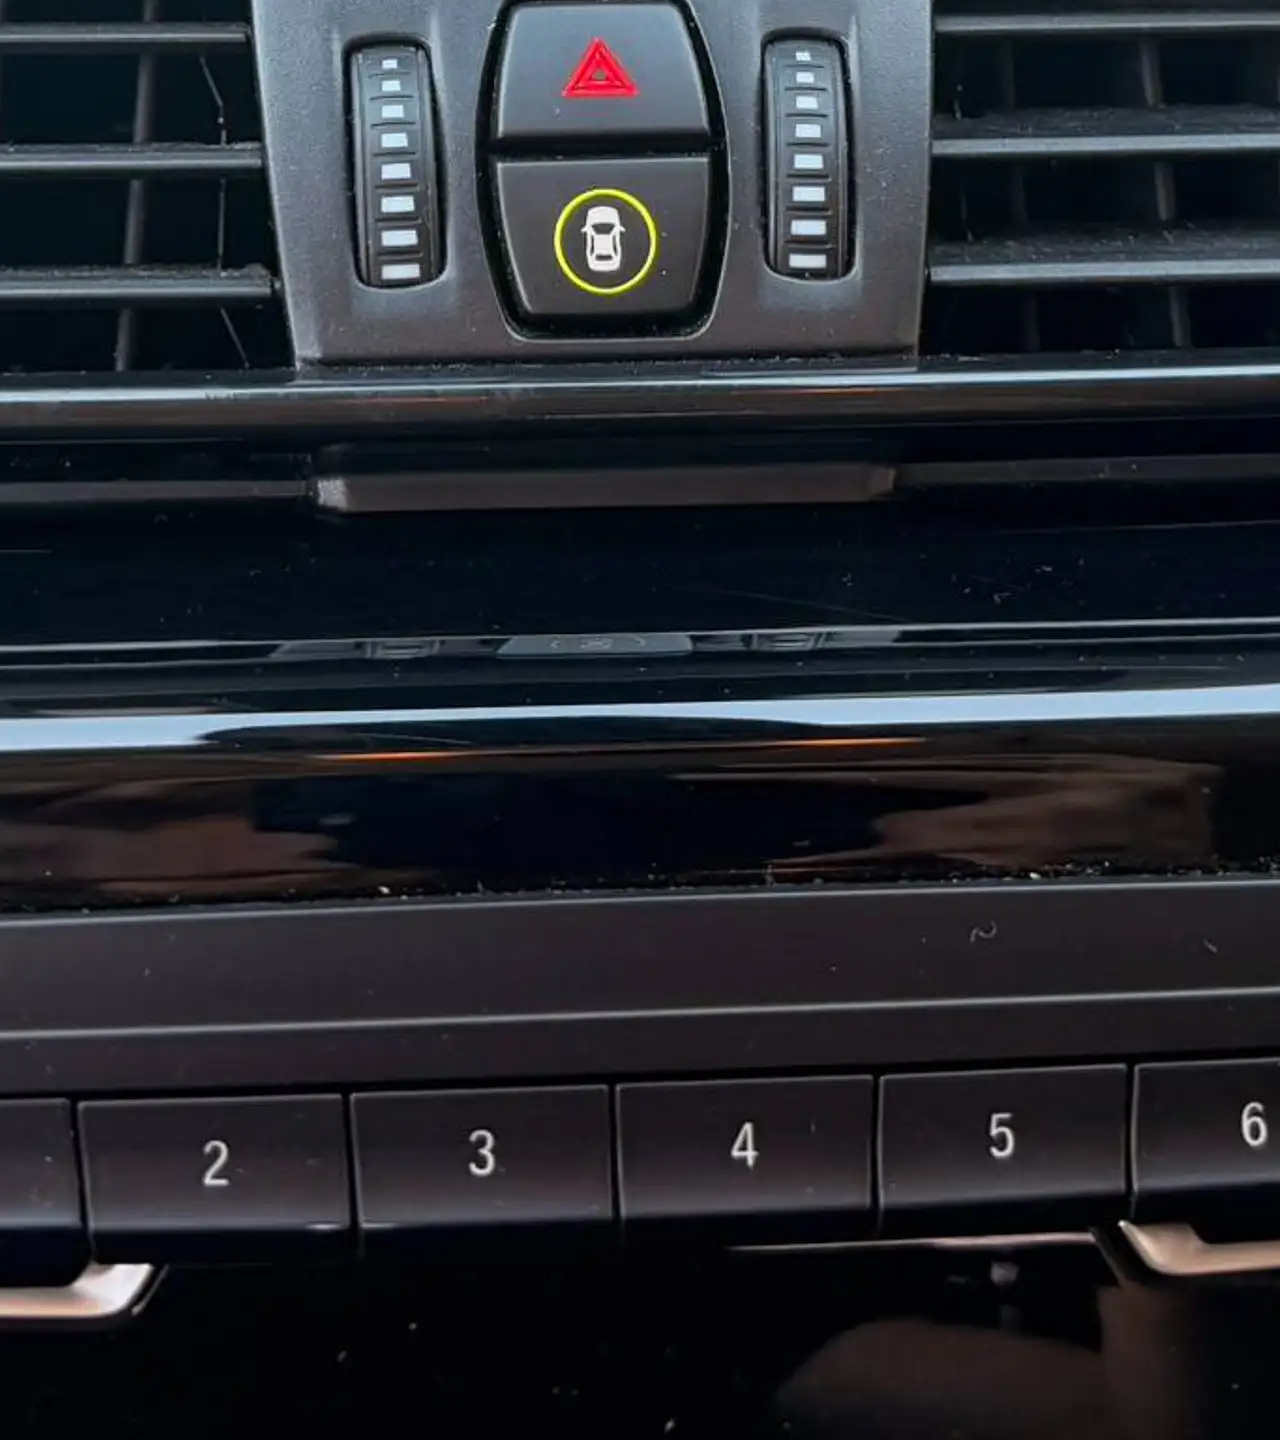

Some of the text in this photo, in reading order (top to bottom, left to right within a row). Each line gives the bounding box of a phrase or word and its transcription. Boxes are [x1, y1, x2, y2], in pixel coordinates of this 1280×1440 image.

[731, 1122, 758, 1167] 4
[990, 1113, 1015, 1159] 5
[1241, 1102, 1268, 1147] 6
[203, 1140, 229, 1187] 2
[469, 1129, 495, 1176] 3
